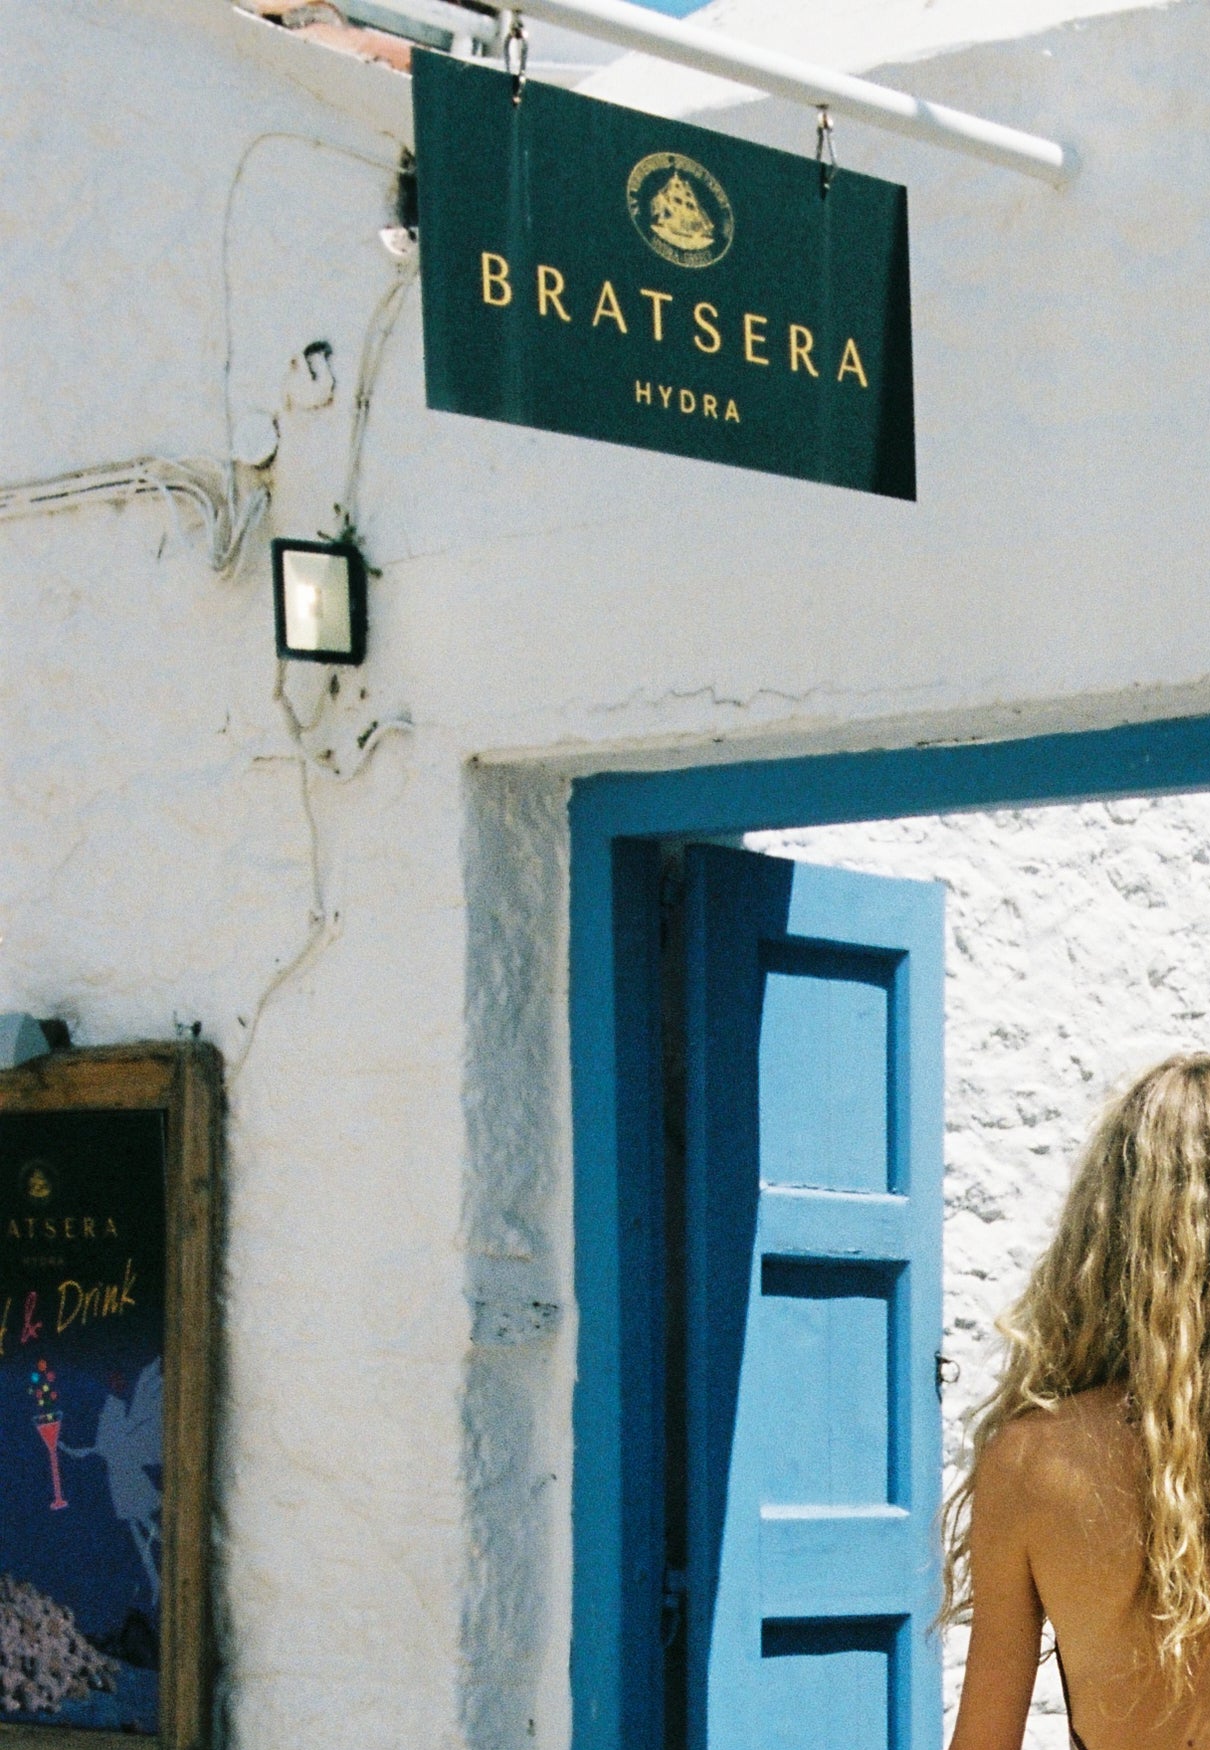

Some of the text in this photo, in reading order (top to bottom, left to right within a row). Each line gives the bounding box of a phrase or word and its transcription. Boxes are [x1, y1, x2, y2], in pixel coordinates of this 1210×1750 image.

[480, 251, 868, 388] BRATSERA
[635, 380, 740, 423] HYDRA
[57, 1258, 136, 1334] Drink
